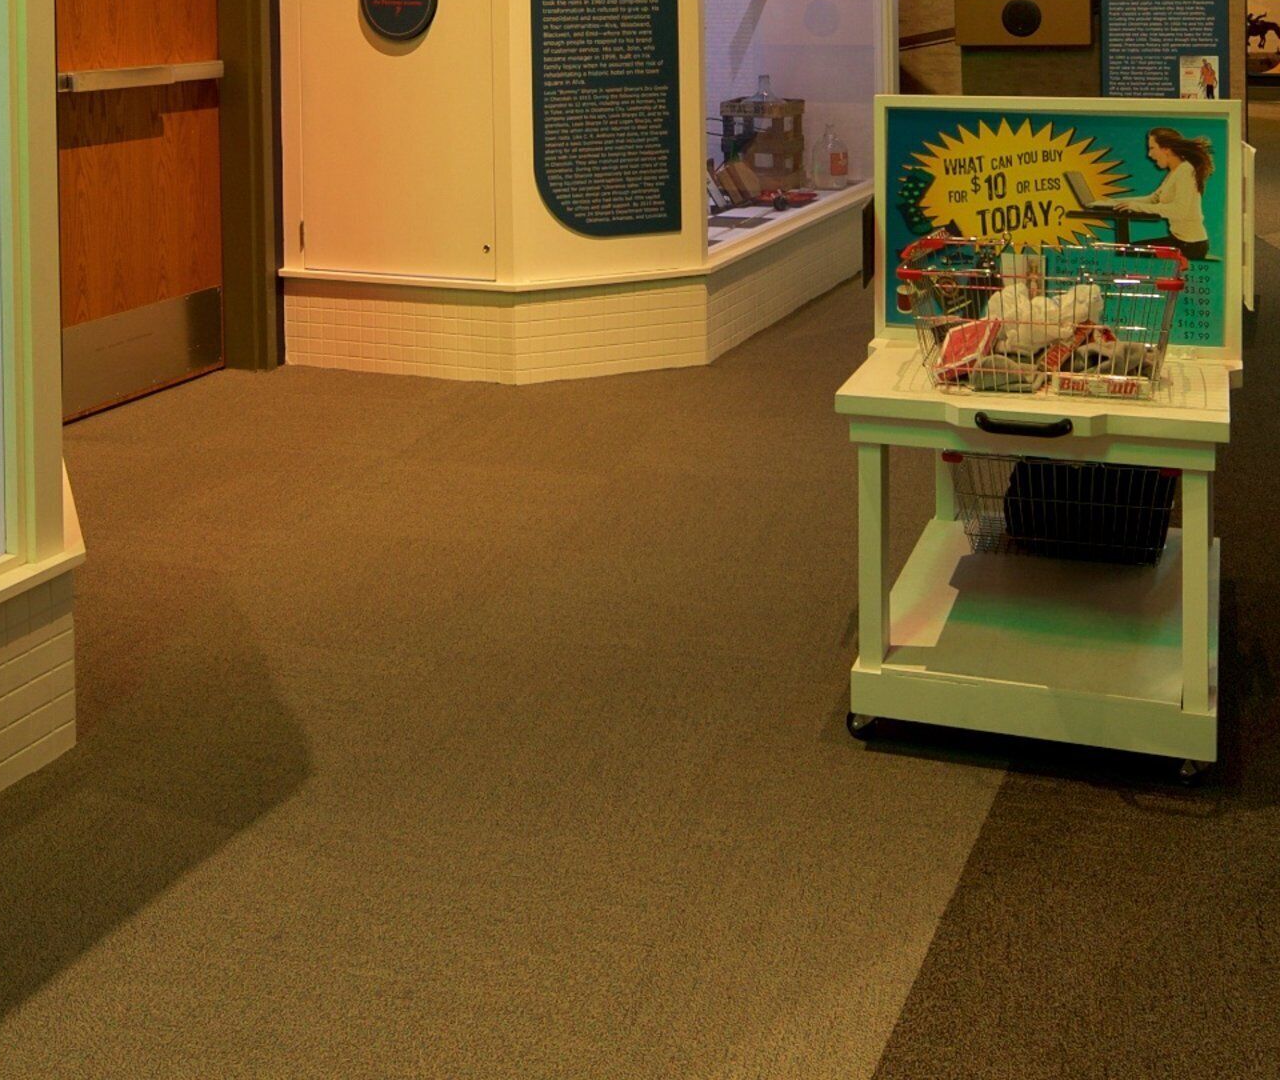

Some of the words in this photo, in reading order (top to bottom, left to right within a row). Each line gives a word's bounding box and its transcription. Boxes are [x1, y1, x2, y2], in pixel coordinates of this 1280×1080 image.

[944, 155, 985, 175] WHAT
[991, 155, 1013, 170] CAN
[1017, 151, 1038, 165] YOU
[1042, 150, 1063, 163] BUY
[948, 190, 968, 203] FOR
[1016, 181, 1030, 193] OR
[1034, 178, 1060, 191] LESS
[976, 200, 1065, 236] TODAY?
